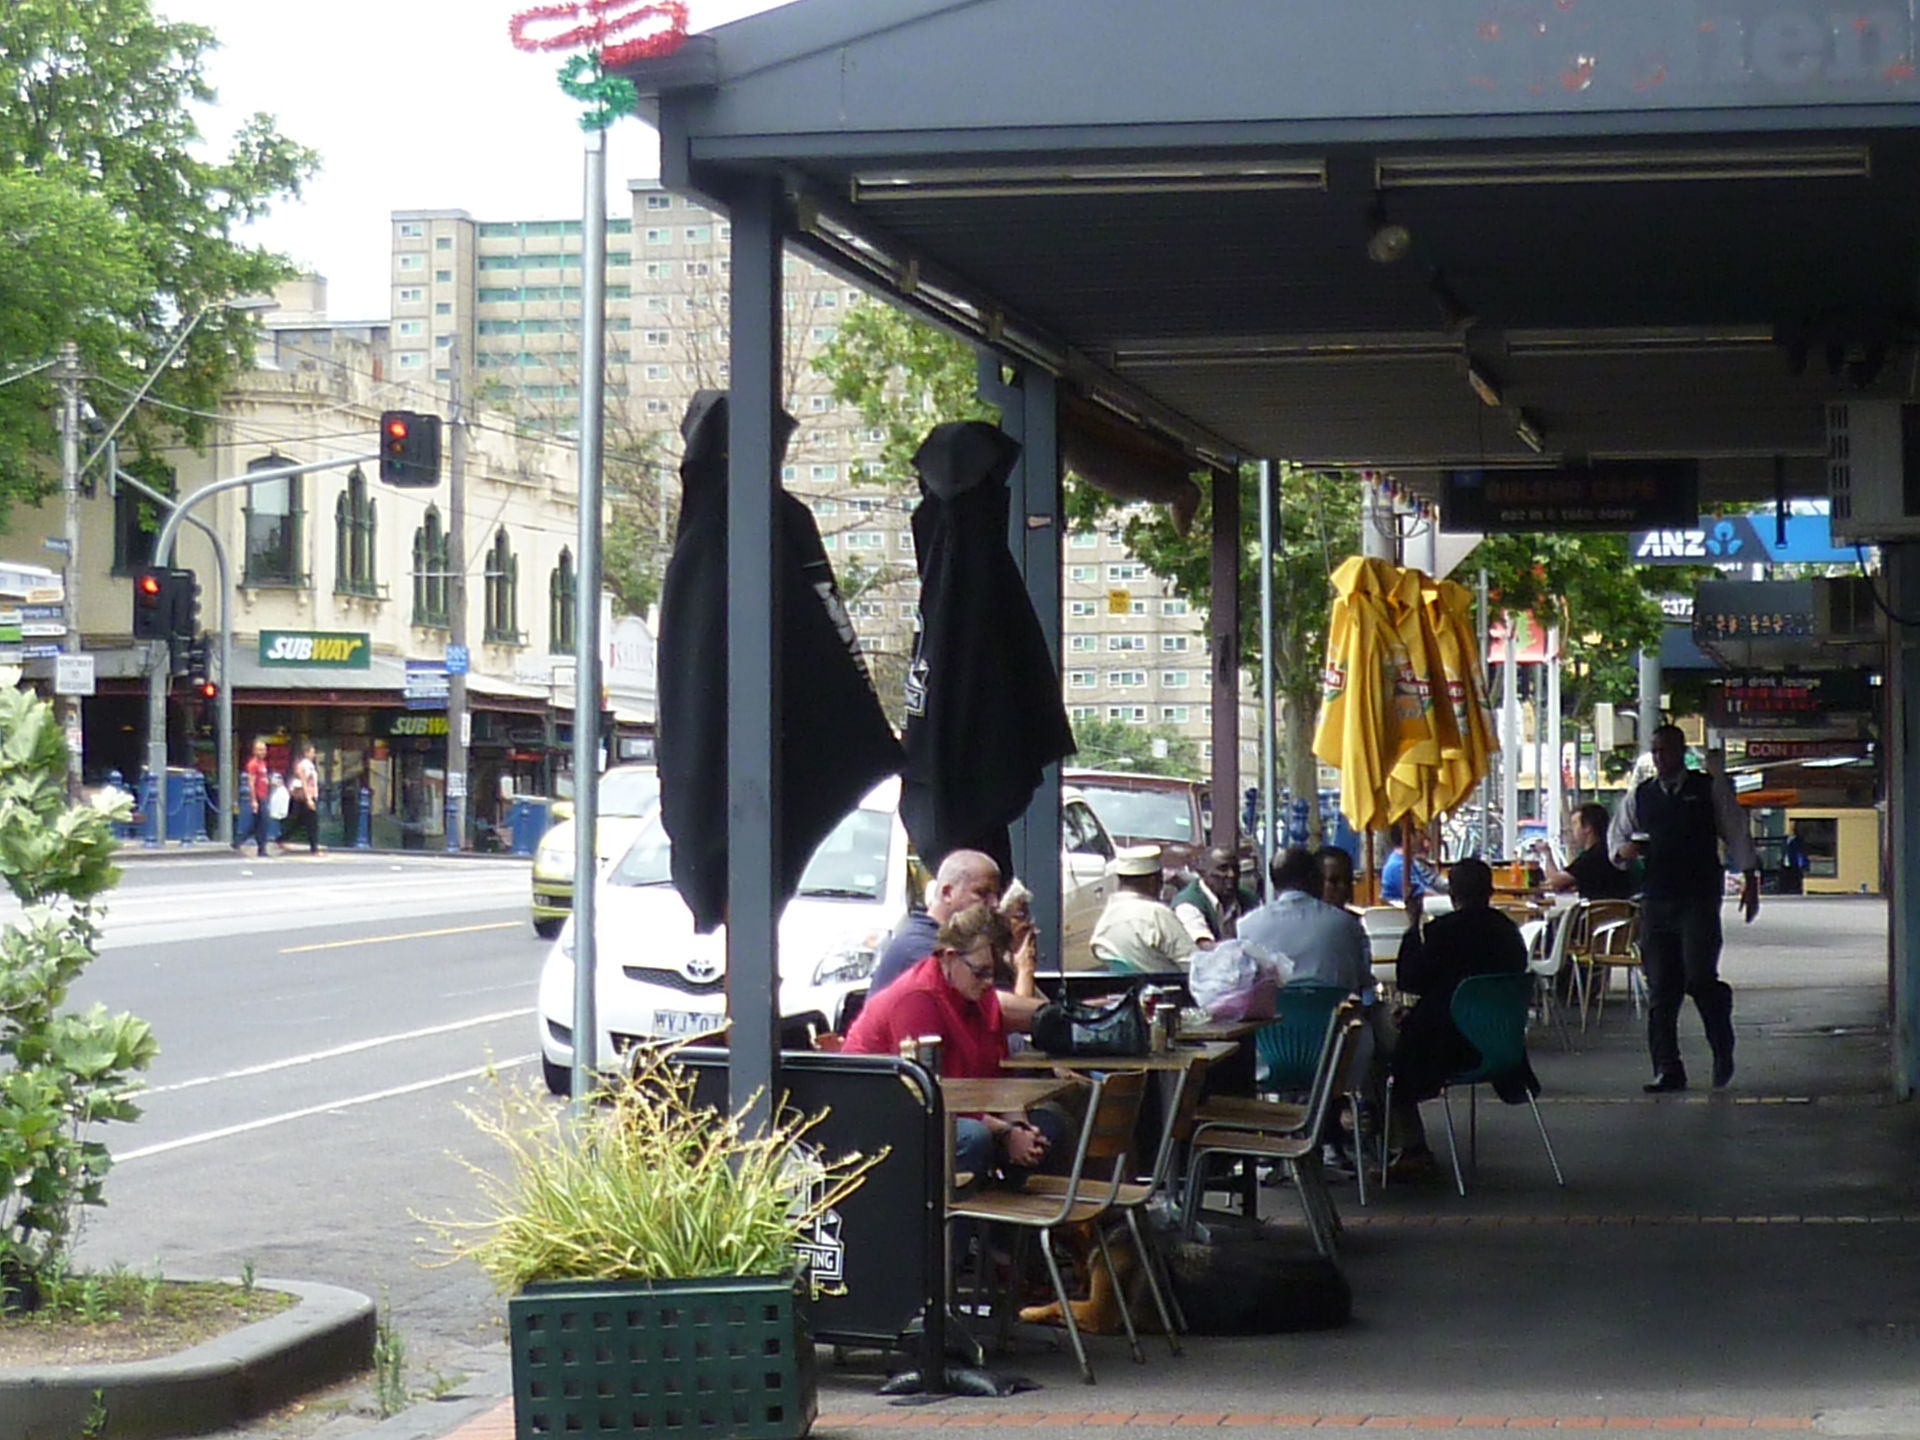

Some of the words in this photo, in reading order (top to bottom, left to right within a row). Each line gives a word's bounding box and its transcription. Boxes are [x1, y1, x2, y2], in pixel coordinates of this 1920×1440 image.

[1636, 530, 1706, 557] ANZ
[267, 636, 362, 662] SUBWAY
[1748, 743, 1788, 757] COIN
